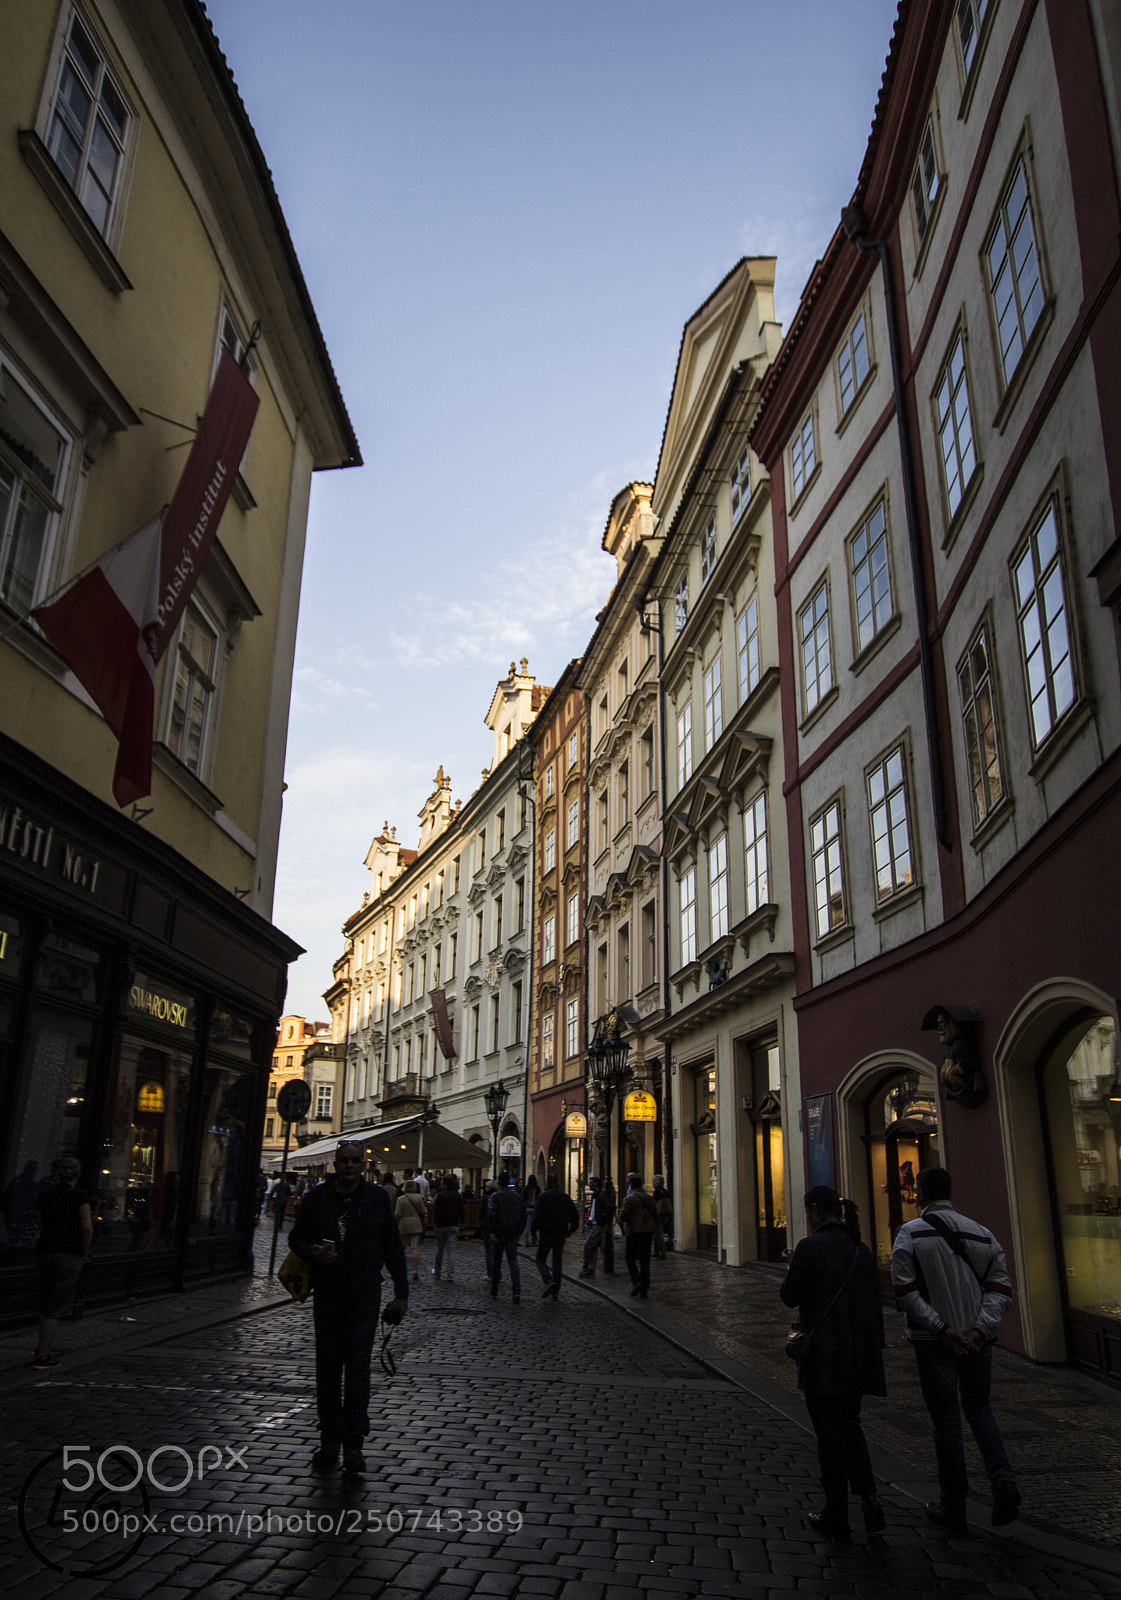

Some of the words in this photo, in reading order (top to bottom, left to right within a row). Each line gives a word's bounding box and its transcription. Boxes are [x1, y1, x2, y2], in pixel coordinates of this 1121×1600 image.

[157, 547, 194, 626] Polský
[188, 459, 227, 548] institut
[129, 985, 187, 1028] SWAROVSKI
